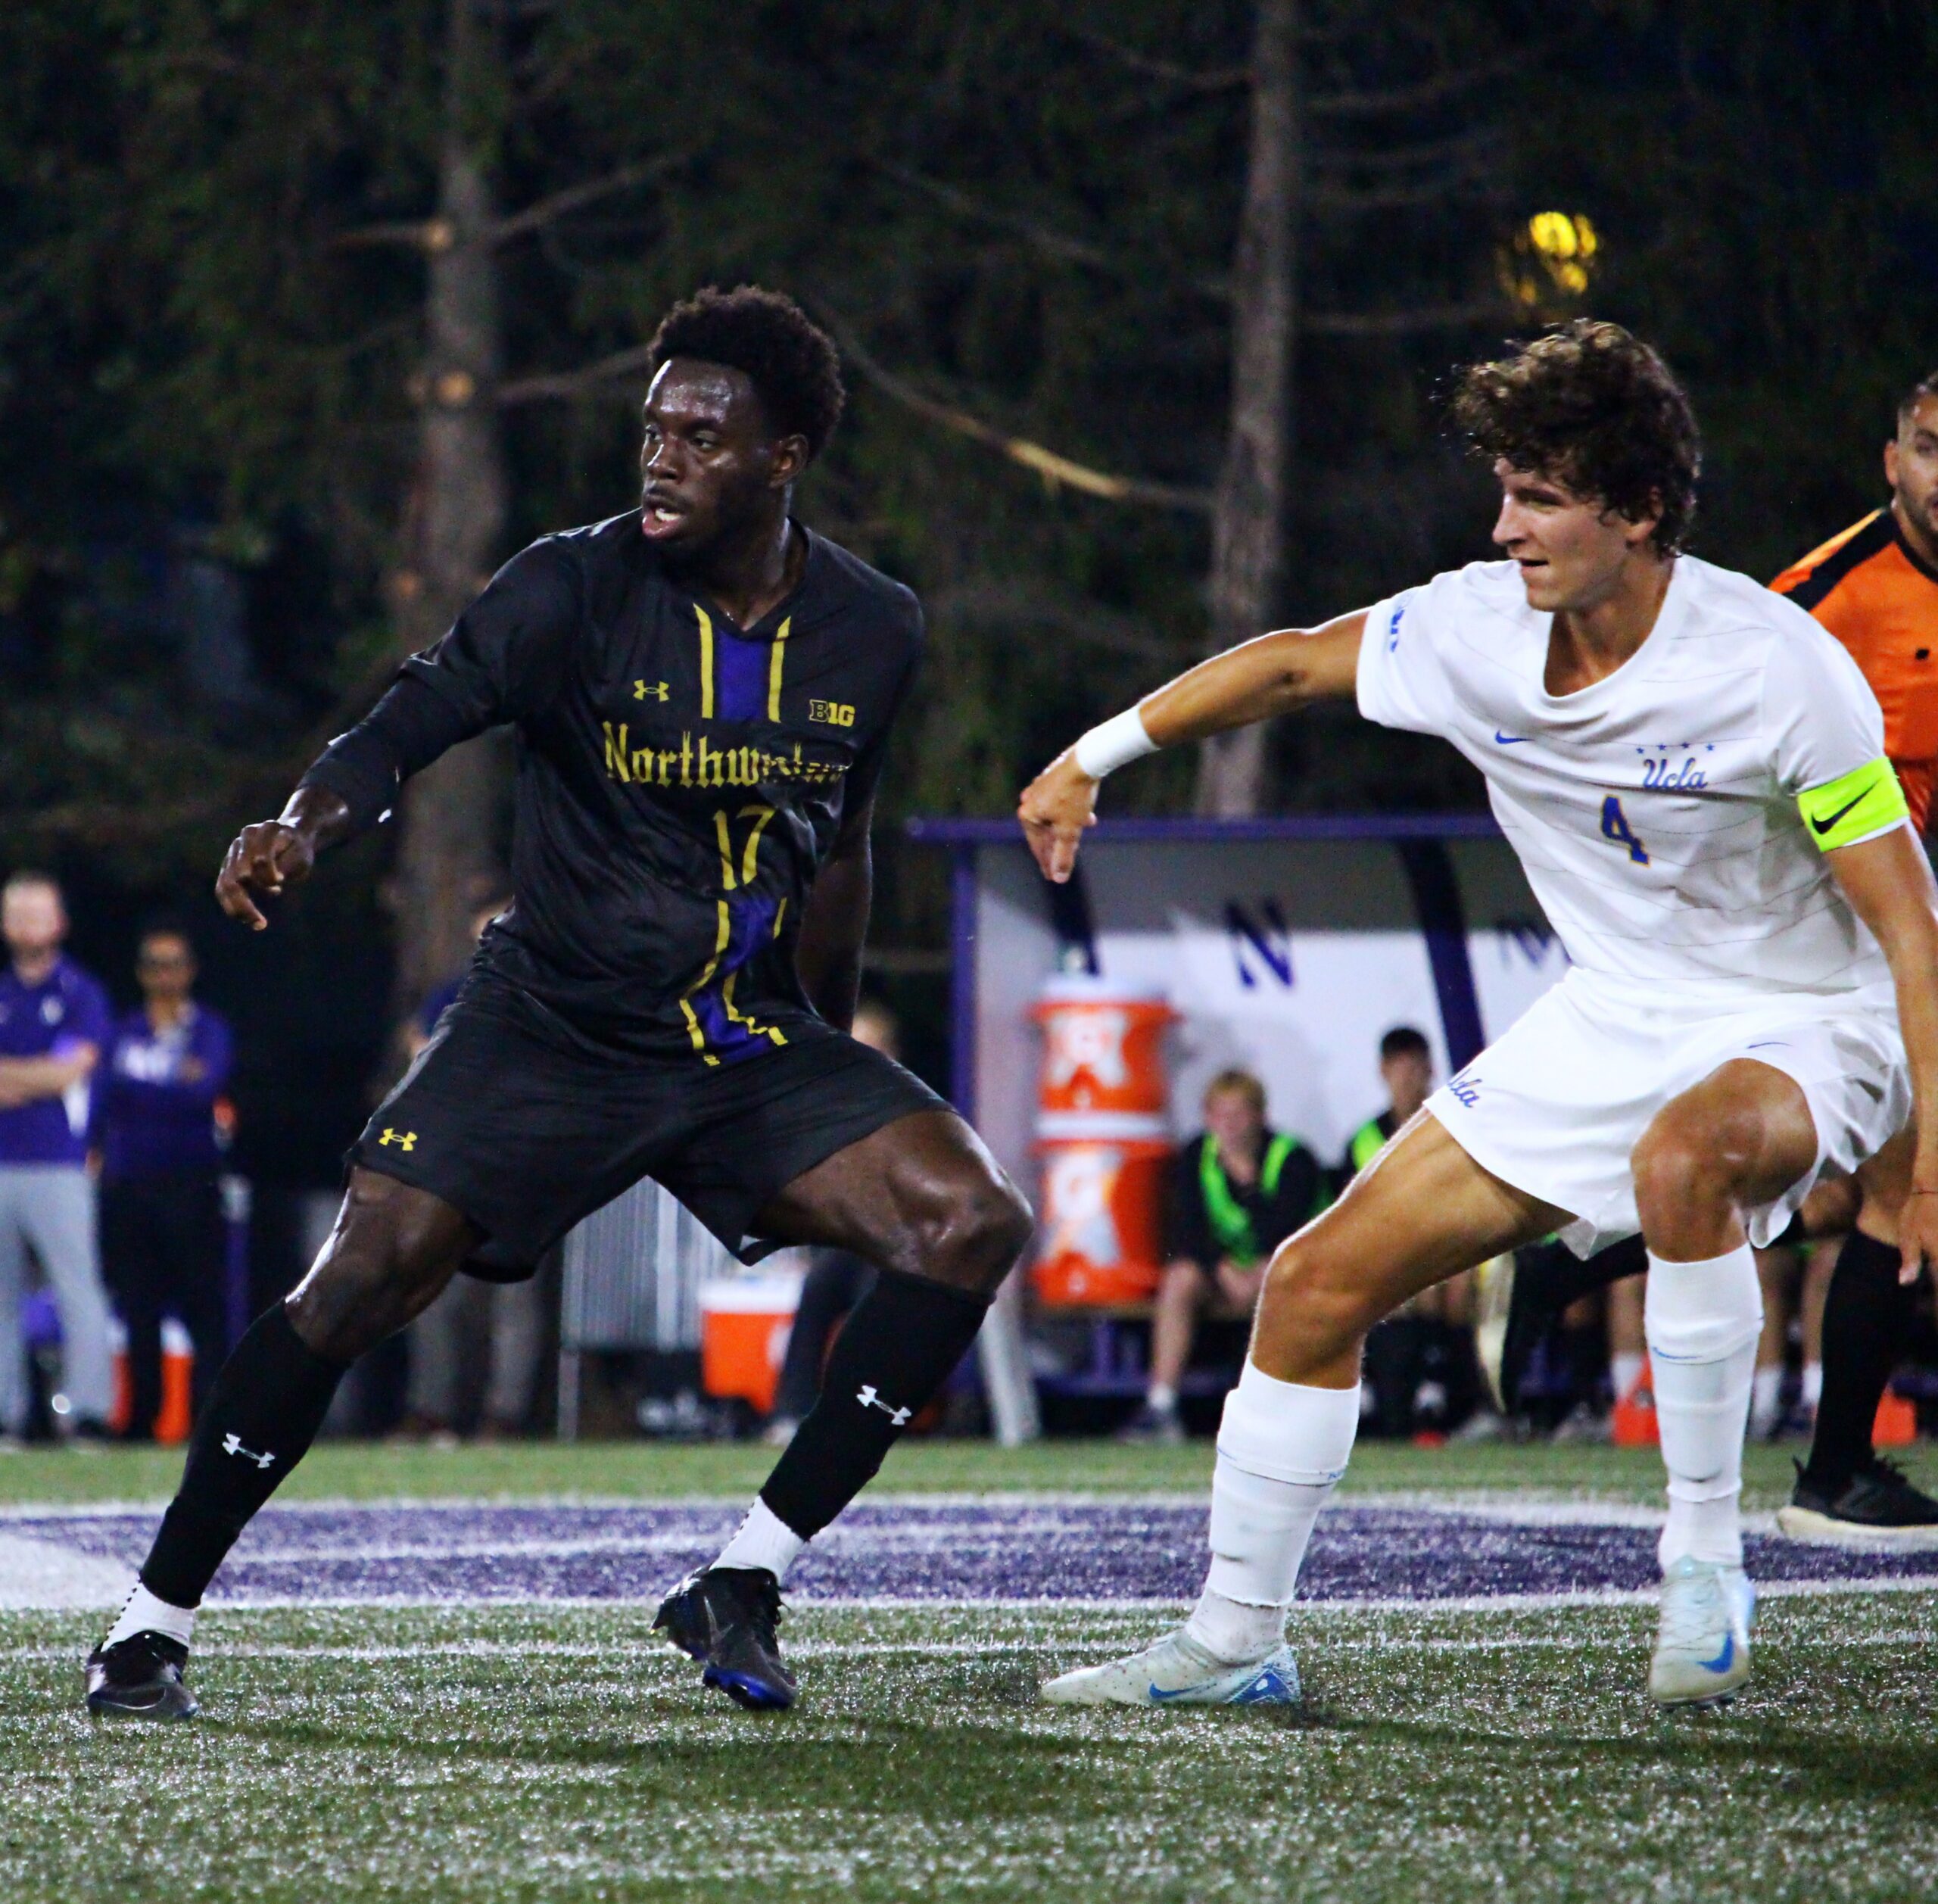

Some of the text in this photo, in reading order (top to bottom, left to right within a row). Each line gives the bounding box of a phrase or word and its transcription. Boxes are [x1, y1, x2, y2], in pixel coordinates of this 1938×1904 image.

[1643, 757, 1709, 790] Ucla
[713, 804, 777, 890] 17
[1600, 794, 1651, 868] 4
